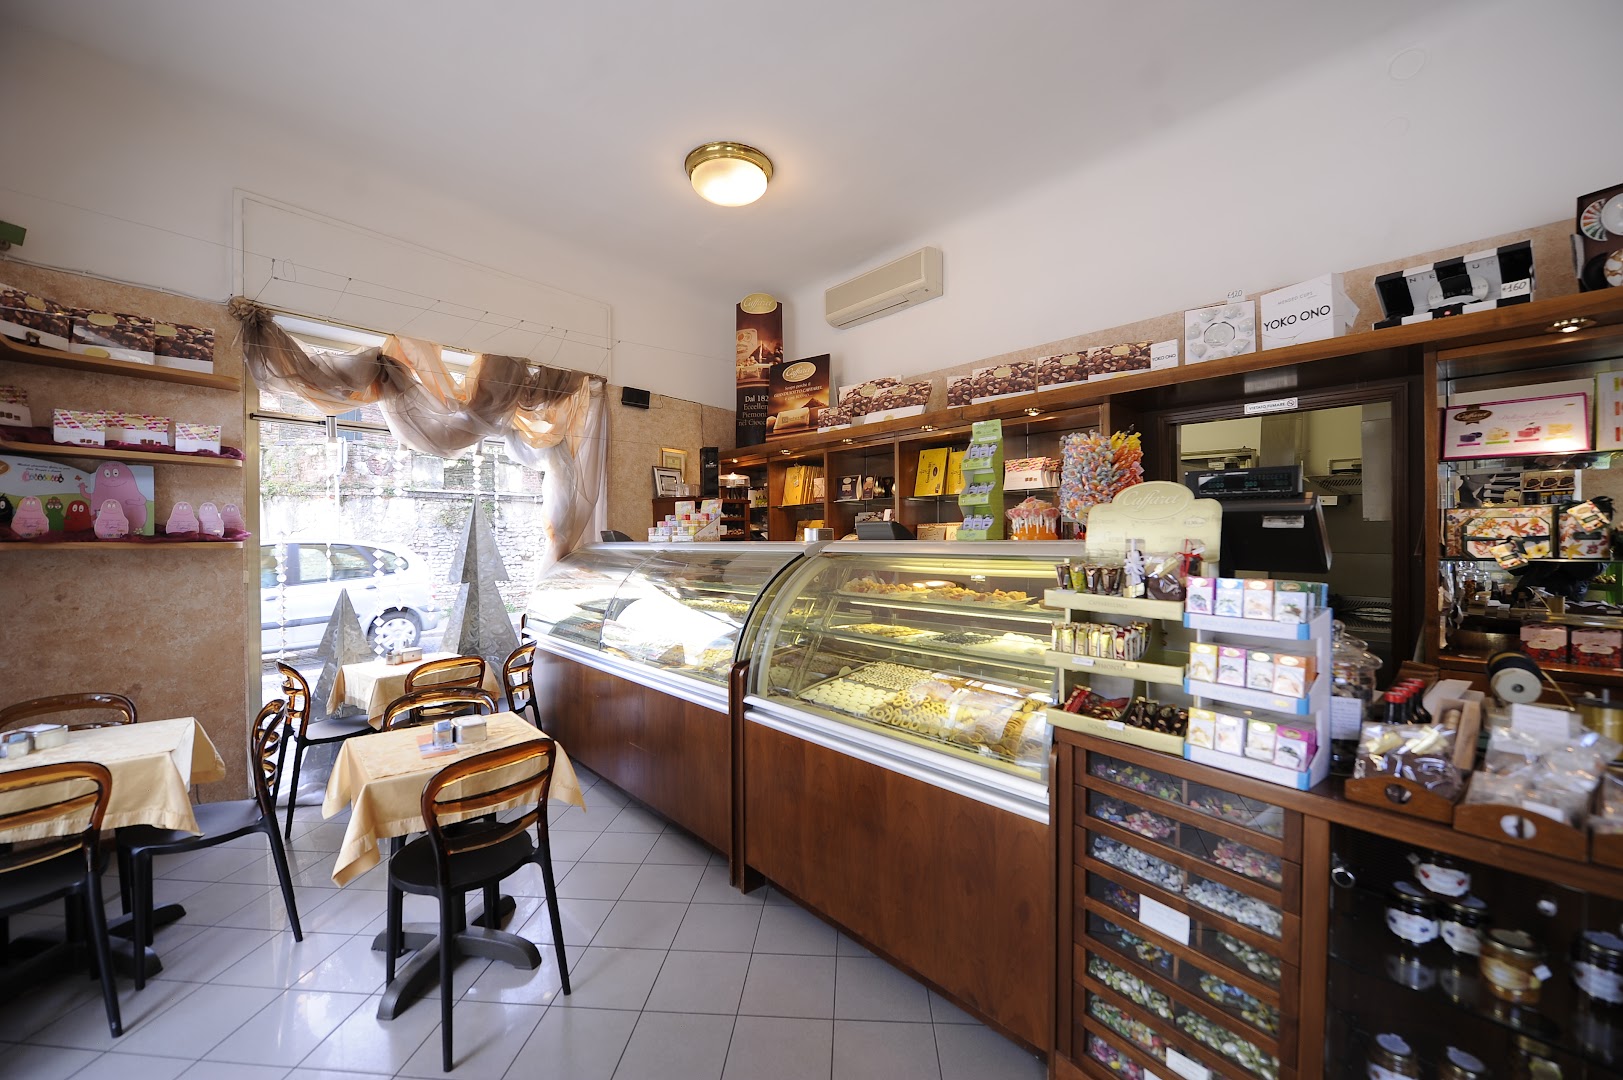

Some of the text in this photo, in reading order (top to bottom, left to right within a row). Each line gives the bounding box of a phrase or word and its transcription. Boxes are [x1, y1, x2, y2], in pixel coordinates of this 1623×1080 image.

[1263, 304, 1331, 332] YOKO ONO
[1122, 489, 1180, 509] Caffarel
